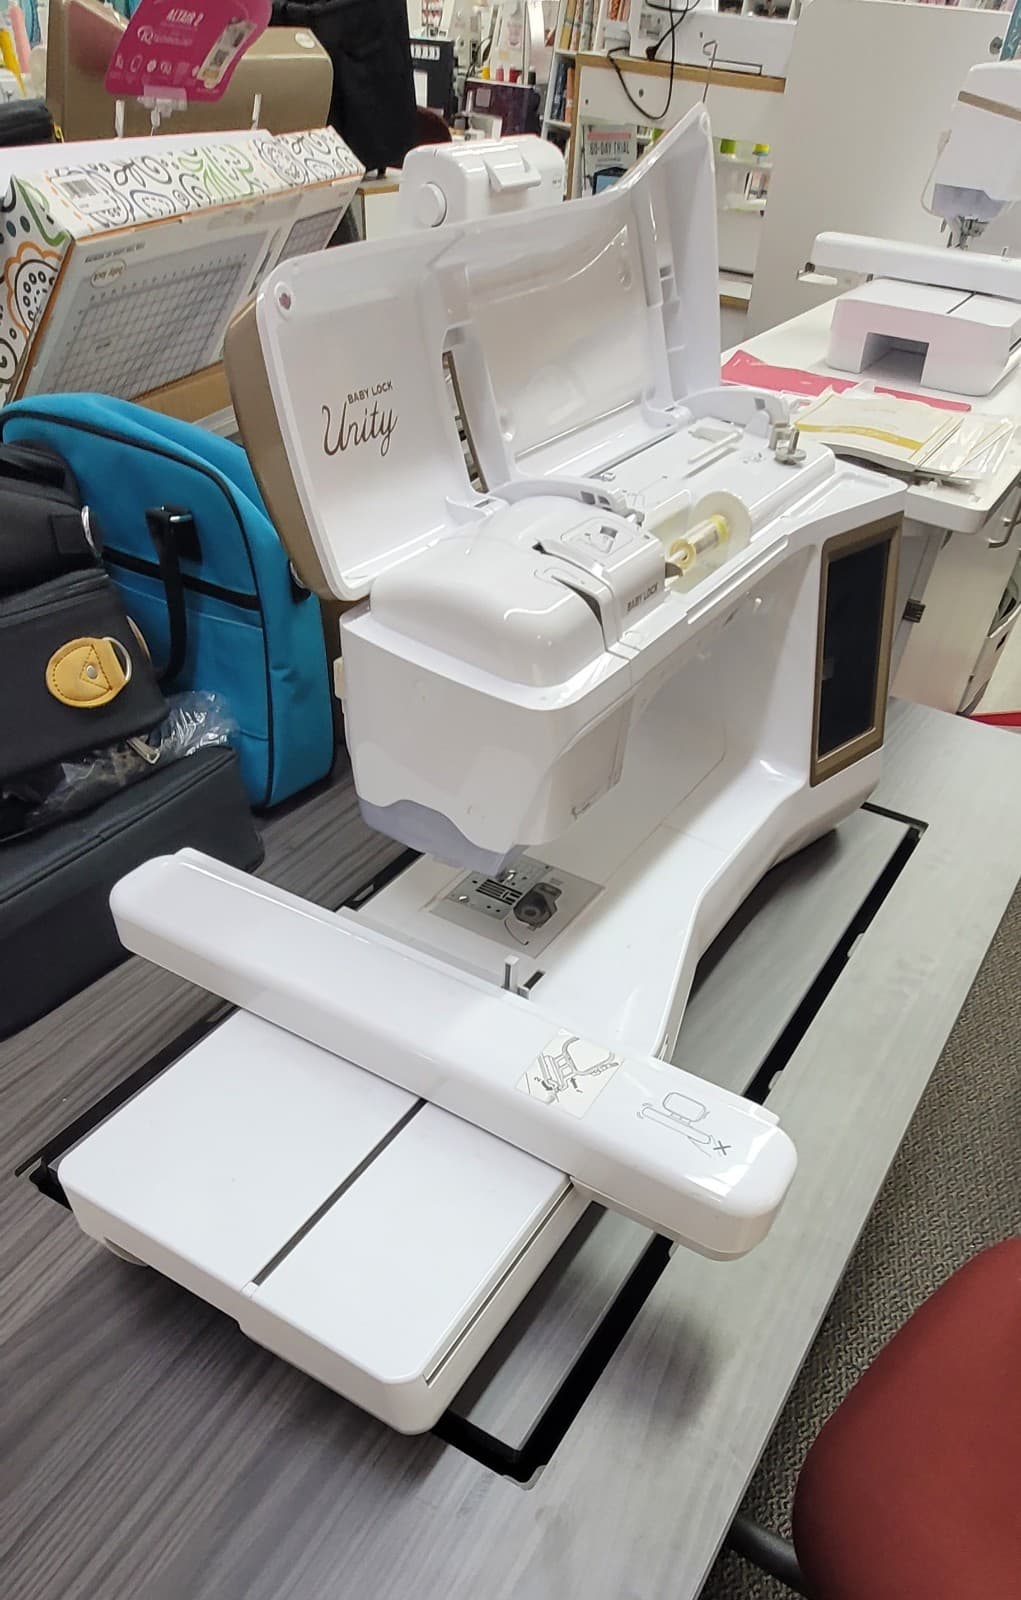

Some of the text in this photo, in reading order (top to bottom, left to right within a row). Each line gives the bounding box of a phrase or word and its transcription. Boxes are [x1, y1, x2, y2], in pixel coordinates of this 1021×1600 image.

[347, 379, 393, 404] BABY LOCK
[321, 400, 398, 456] Unity
